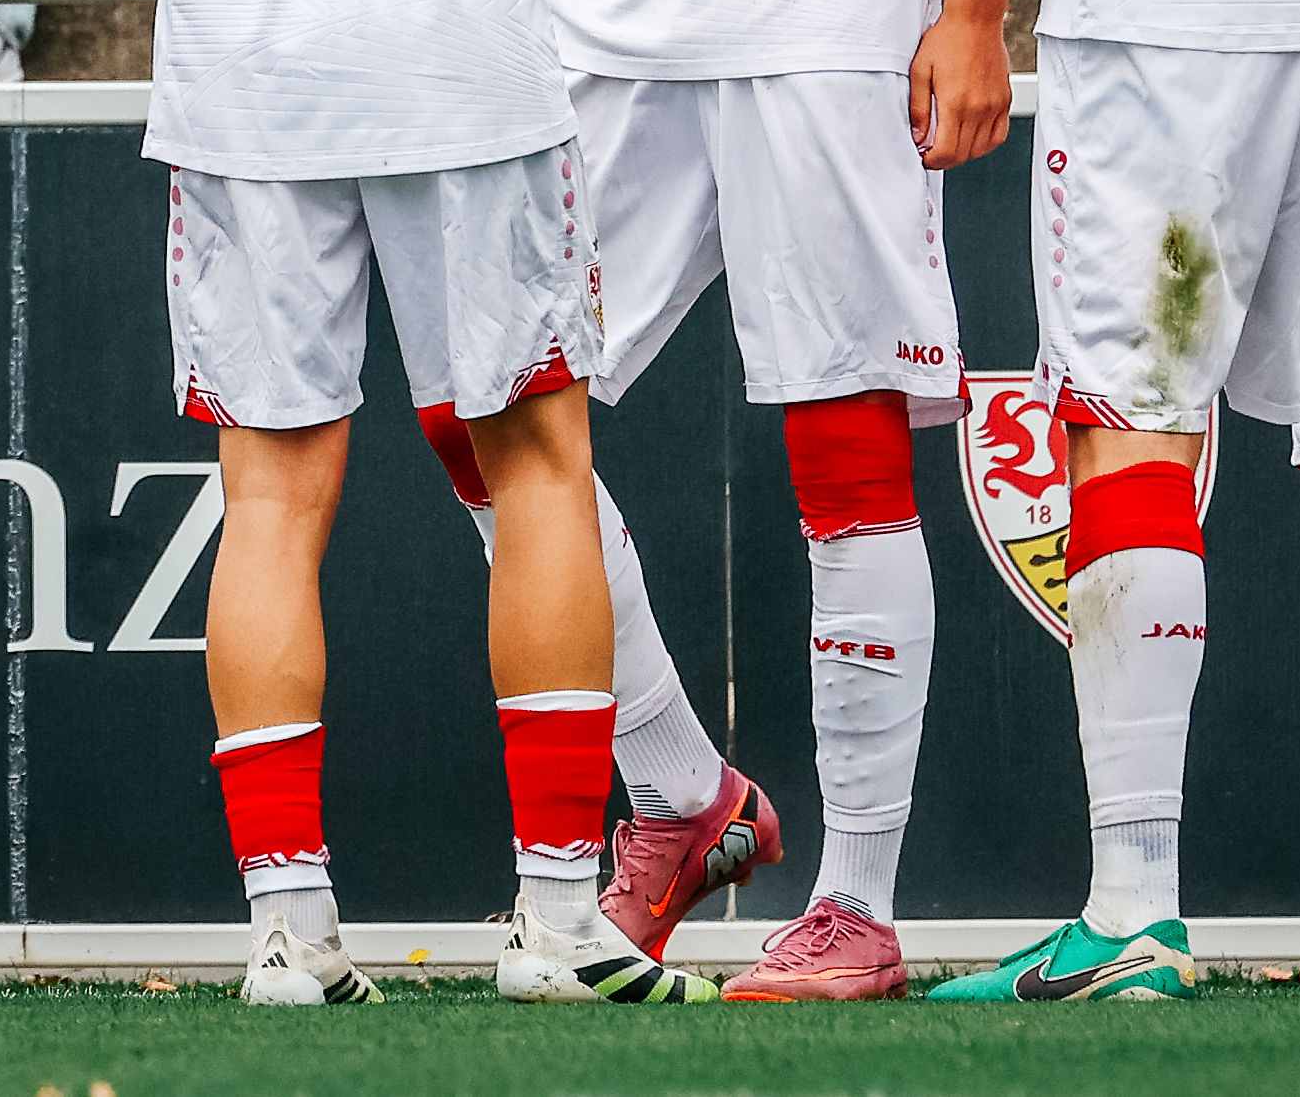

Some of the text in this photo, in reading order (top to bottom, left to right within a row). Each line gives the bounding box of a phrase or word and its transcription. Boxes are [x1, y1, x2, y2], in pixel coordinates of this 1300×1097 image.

[896, 340, 944, 365] JAKO
[1026, 504, 1052, 525] 18
[813, 637, 896, 660] VfB
